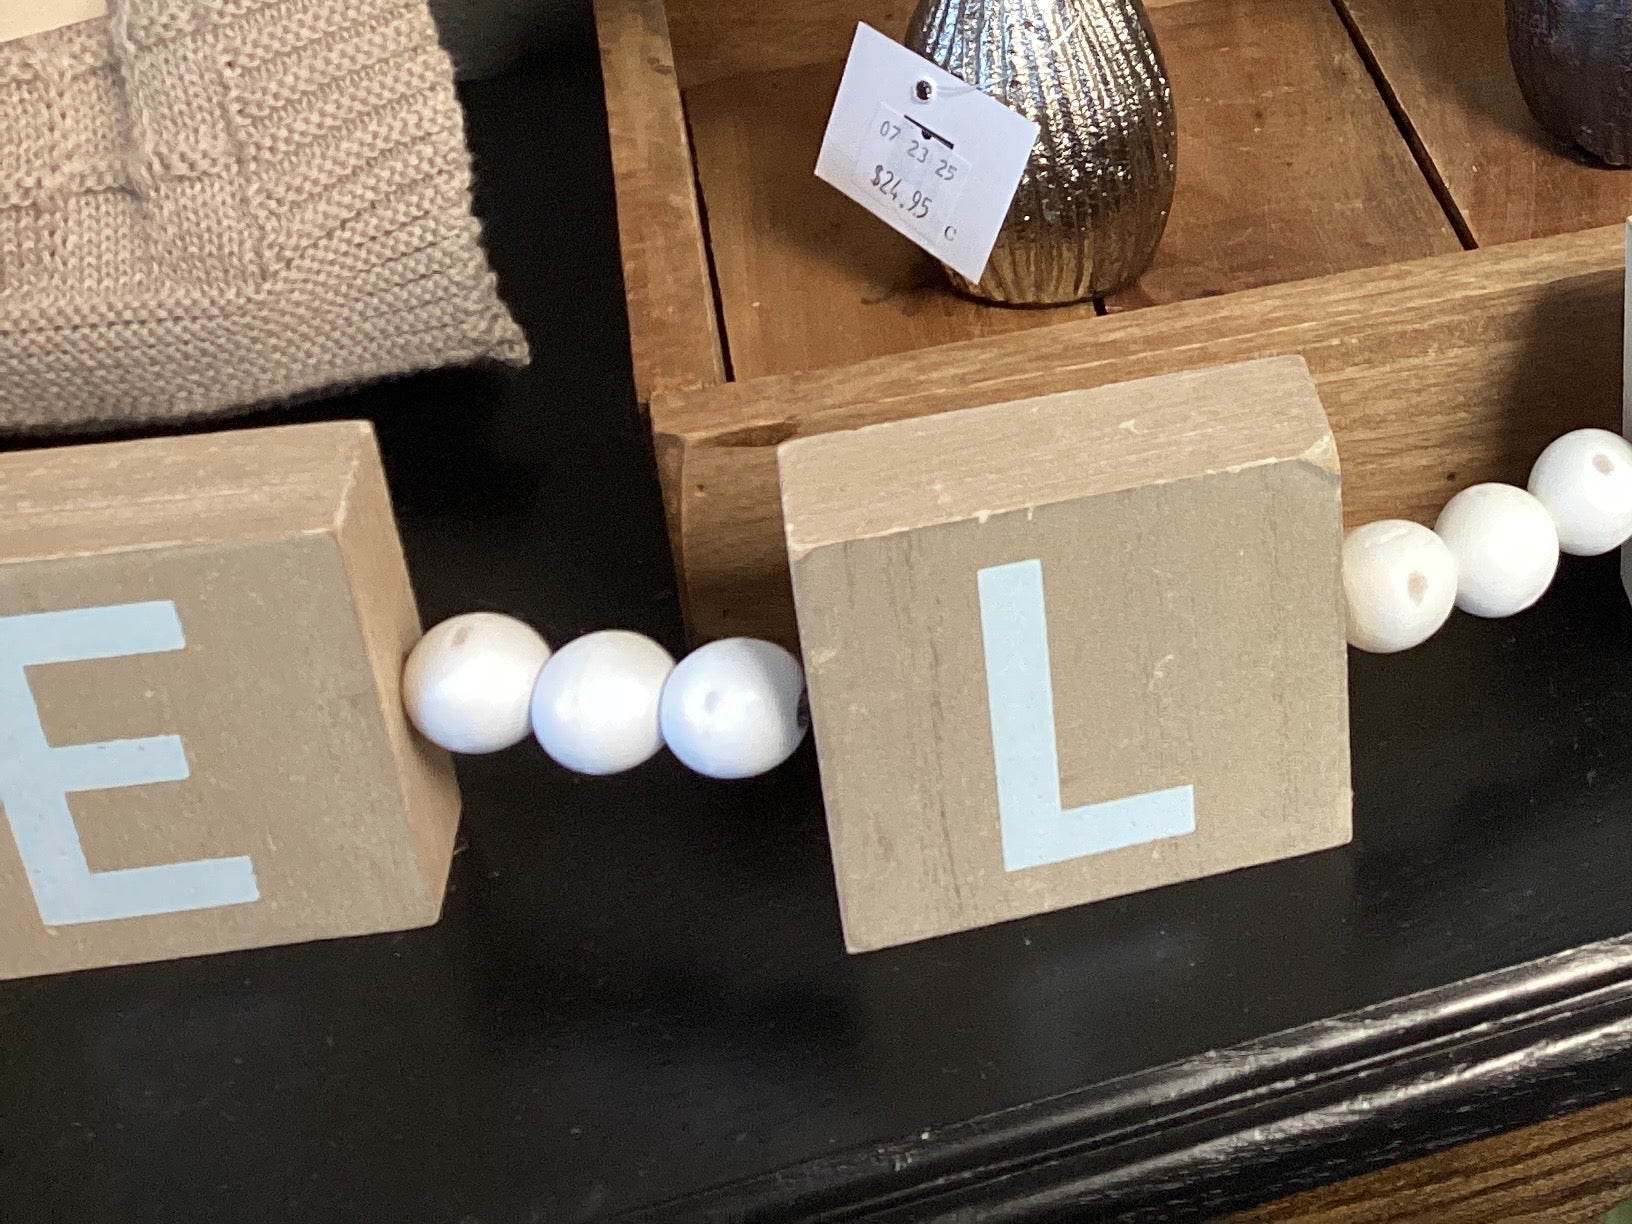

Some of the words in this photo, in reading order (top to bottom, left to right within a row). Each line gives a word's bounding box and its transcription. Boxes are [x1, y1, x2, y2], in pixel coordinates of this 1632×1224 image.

[880, 120, 901, 141] 07
[907, 140, 929, 163] 23
[935, 159, 958, 181] 25
[870, 164, 933, 219] $24.95
